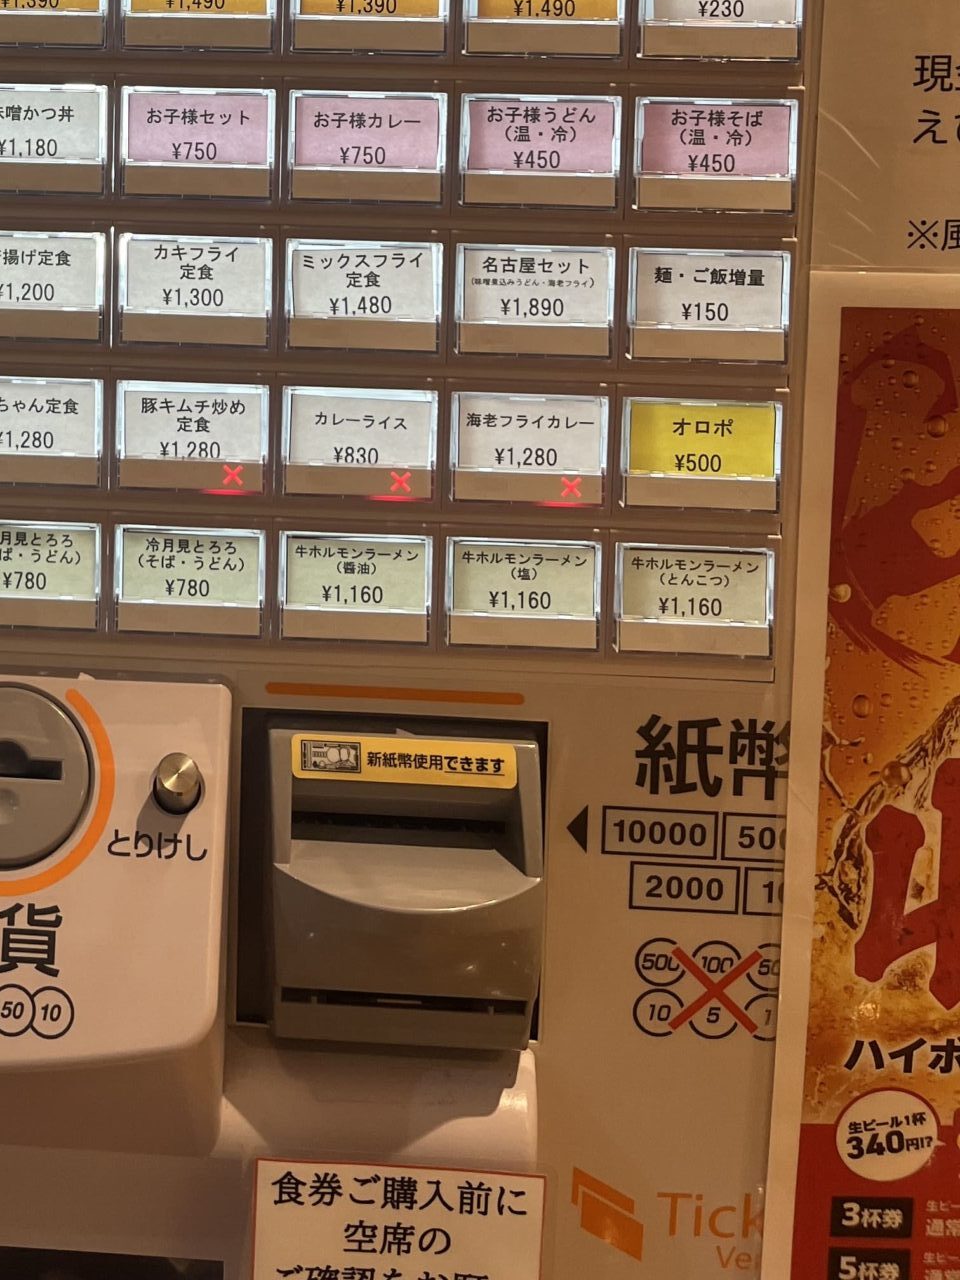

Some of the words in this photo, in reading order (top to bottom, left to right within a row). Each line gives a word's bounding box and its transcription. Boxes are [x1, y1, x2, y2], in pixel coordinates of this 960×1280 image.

[699, 0, 744, 17] ¥230
[147, 108, 249, 125] お子様セット
[314, 112, 420, 129] お子様カレー
[488, 106, 595, 123] お子様うどん
[672, 109, 763, 127] お子様そば
[173, 142, 216, 160] ¥750
[339, 145, 387, 166] ¥750
[513, 150, 562, 170] ¥450
[688, 154, 739, 175] ¥450
[483, 257, 589, 274] 名古屋セット
[682, 303, 728, 321] ¥150
[315, 412, 407, 429] カレーライス
[466, 413, 594, 429] 海老フライカレー
[673, 418, 733, 437] オロポ
[675, 454, 721, 472] ¥500
[146, 537, 236, 559] 冷月見とろろ
[3, 571, 46, 590] ¥780
[166, 579, 209, 596] ¥780
[366, 751, 506, 774] 新紙幣使用できます
[613, 819, 707, 846] 10000
[106, 829, 208, 862] とりけし
[645, 875, 724, 901] 2000
[701, 956, 734, 974] 100
[0, 1000, 25, 1021] 50
[40, 1002, 62, 1023] 10
[649, 1004, 672, 1021] 10
[706, 1006, 721, 1023] 5
[848, 1111, 927, 1135] 生ビール1杯
[271, 1171, 528, 1216] 食券ご購入前に
[343, 1220, 452, 1255] 空席の
